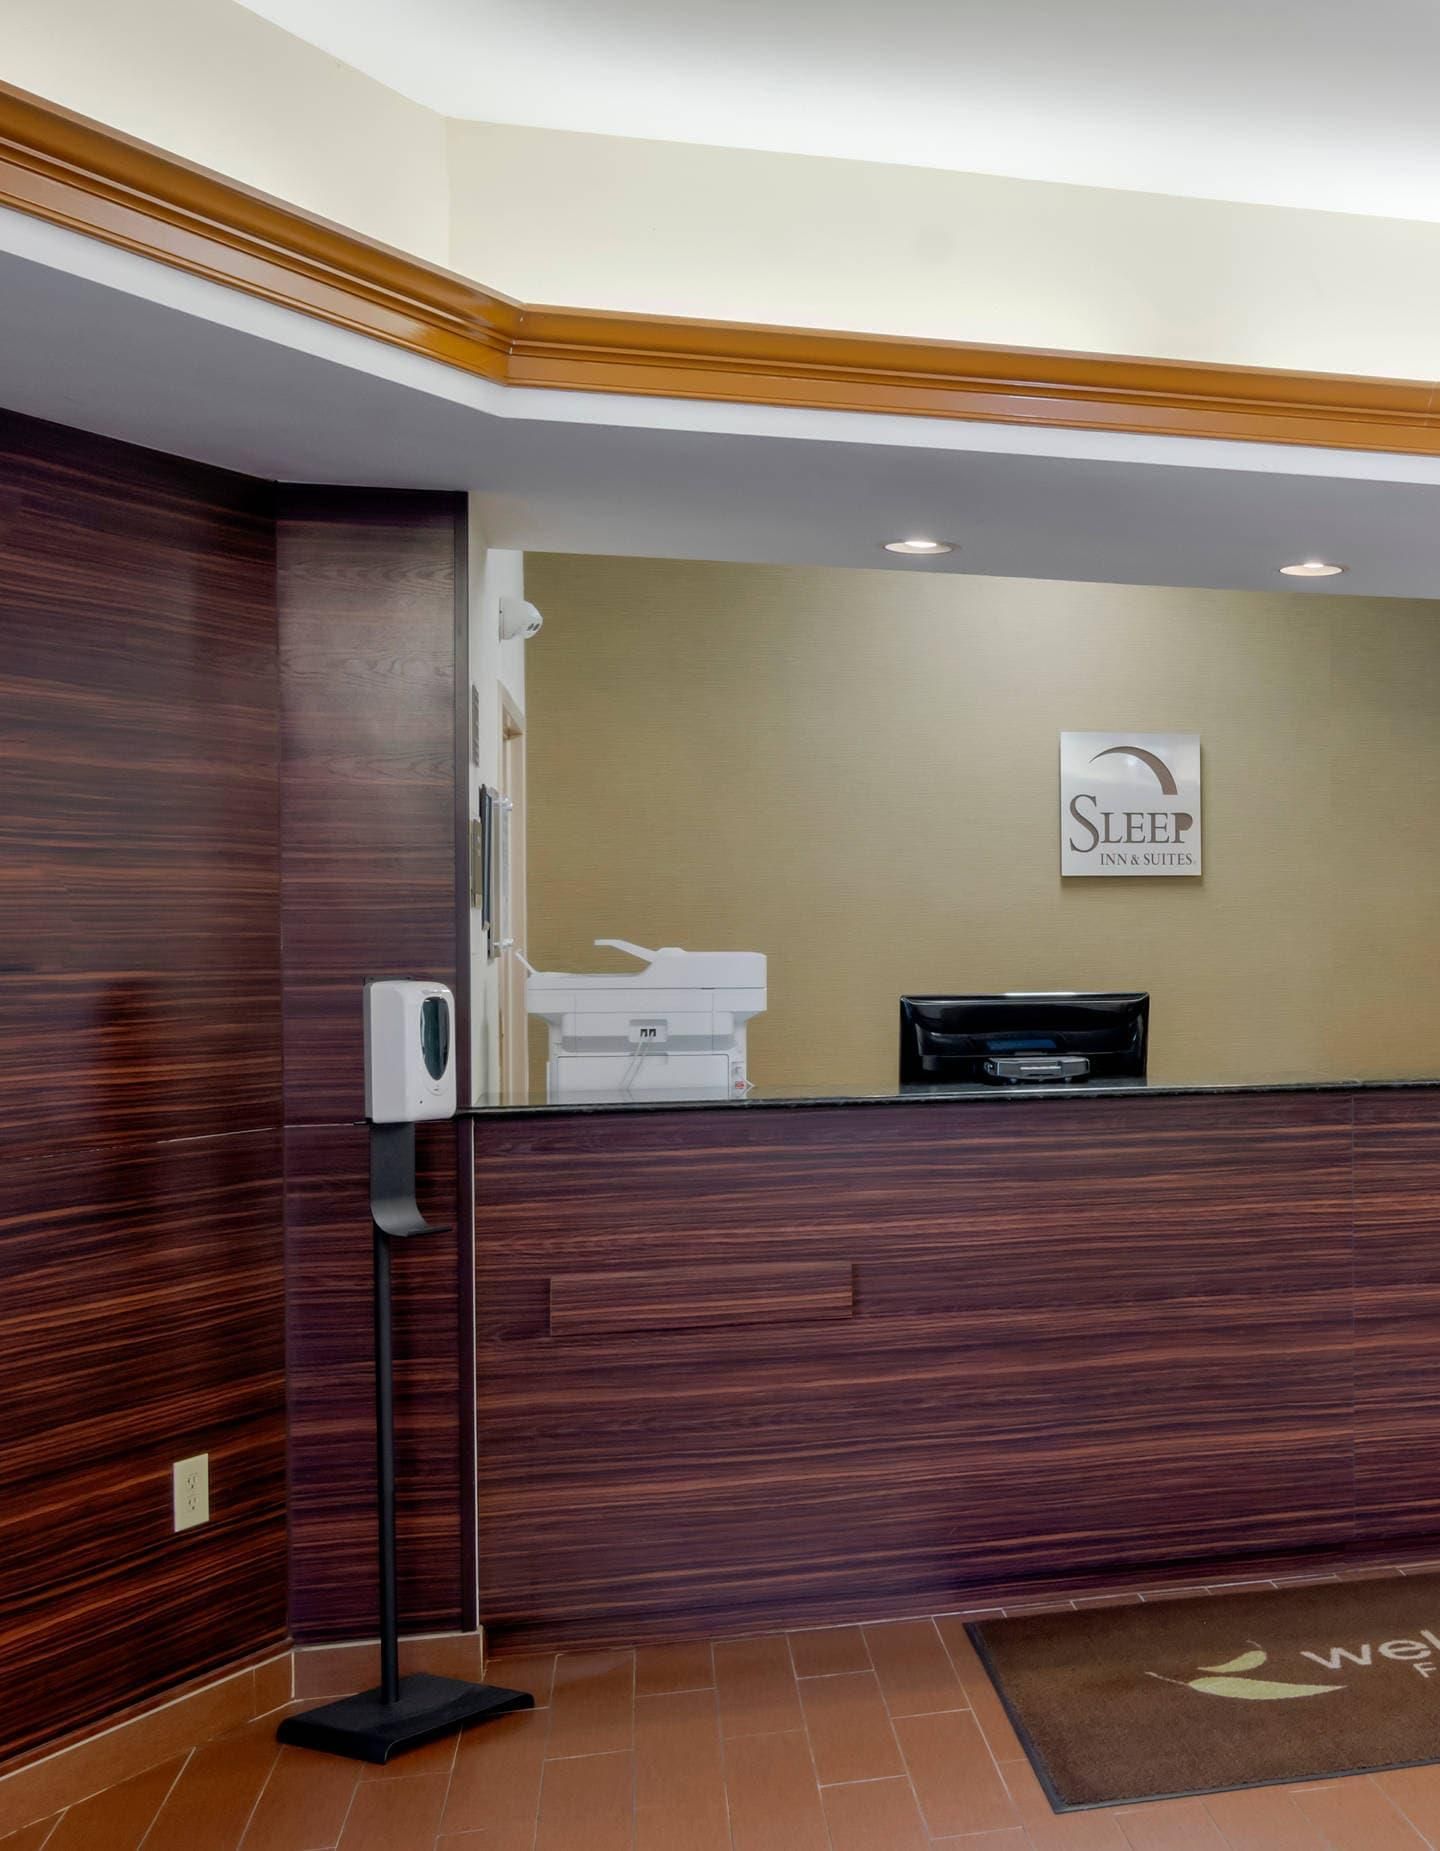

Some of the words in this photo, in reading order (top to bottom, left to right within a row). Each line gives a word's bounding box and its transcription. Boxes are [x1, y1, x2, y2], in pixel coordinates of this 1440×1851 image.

[1069, 794, 1193, 853] SLEEP
[1100, 853, 1127, 866] INN
[1130, 853, 1140, 866] &
[1143, 852, 1193, 866] SUITES
